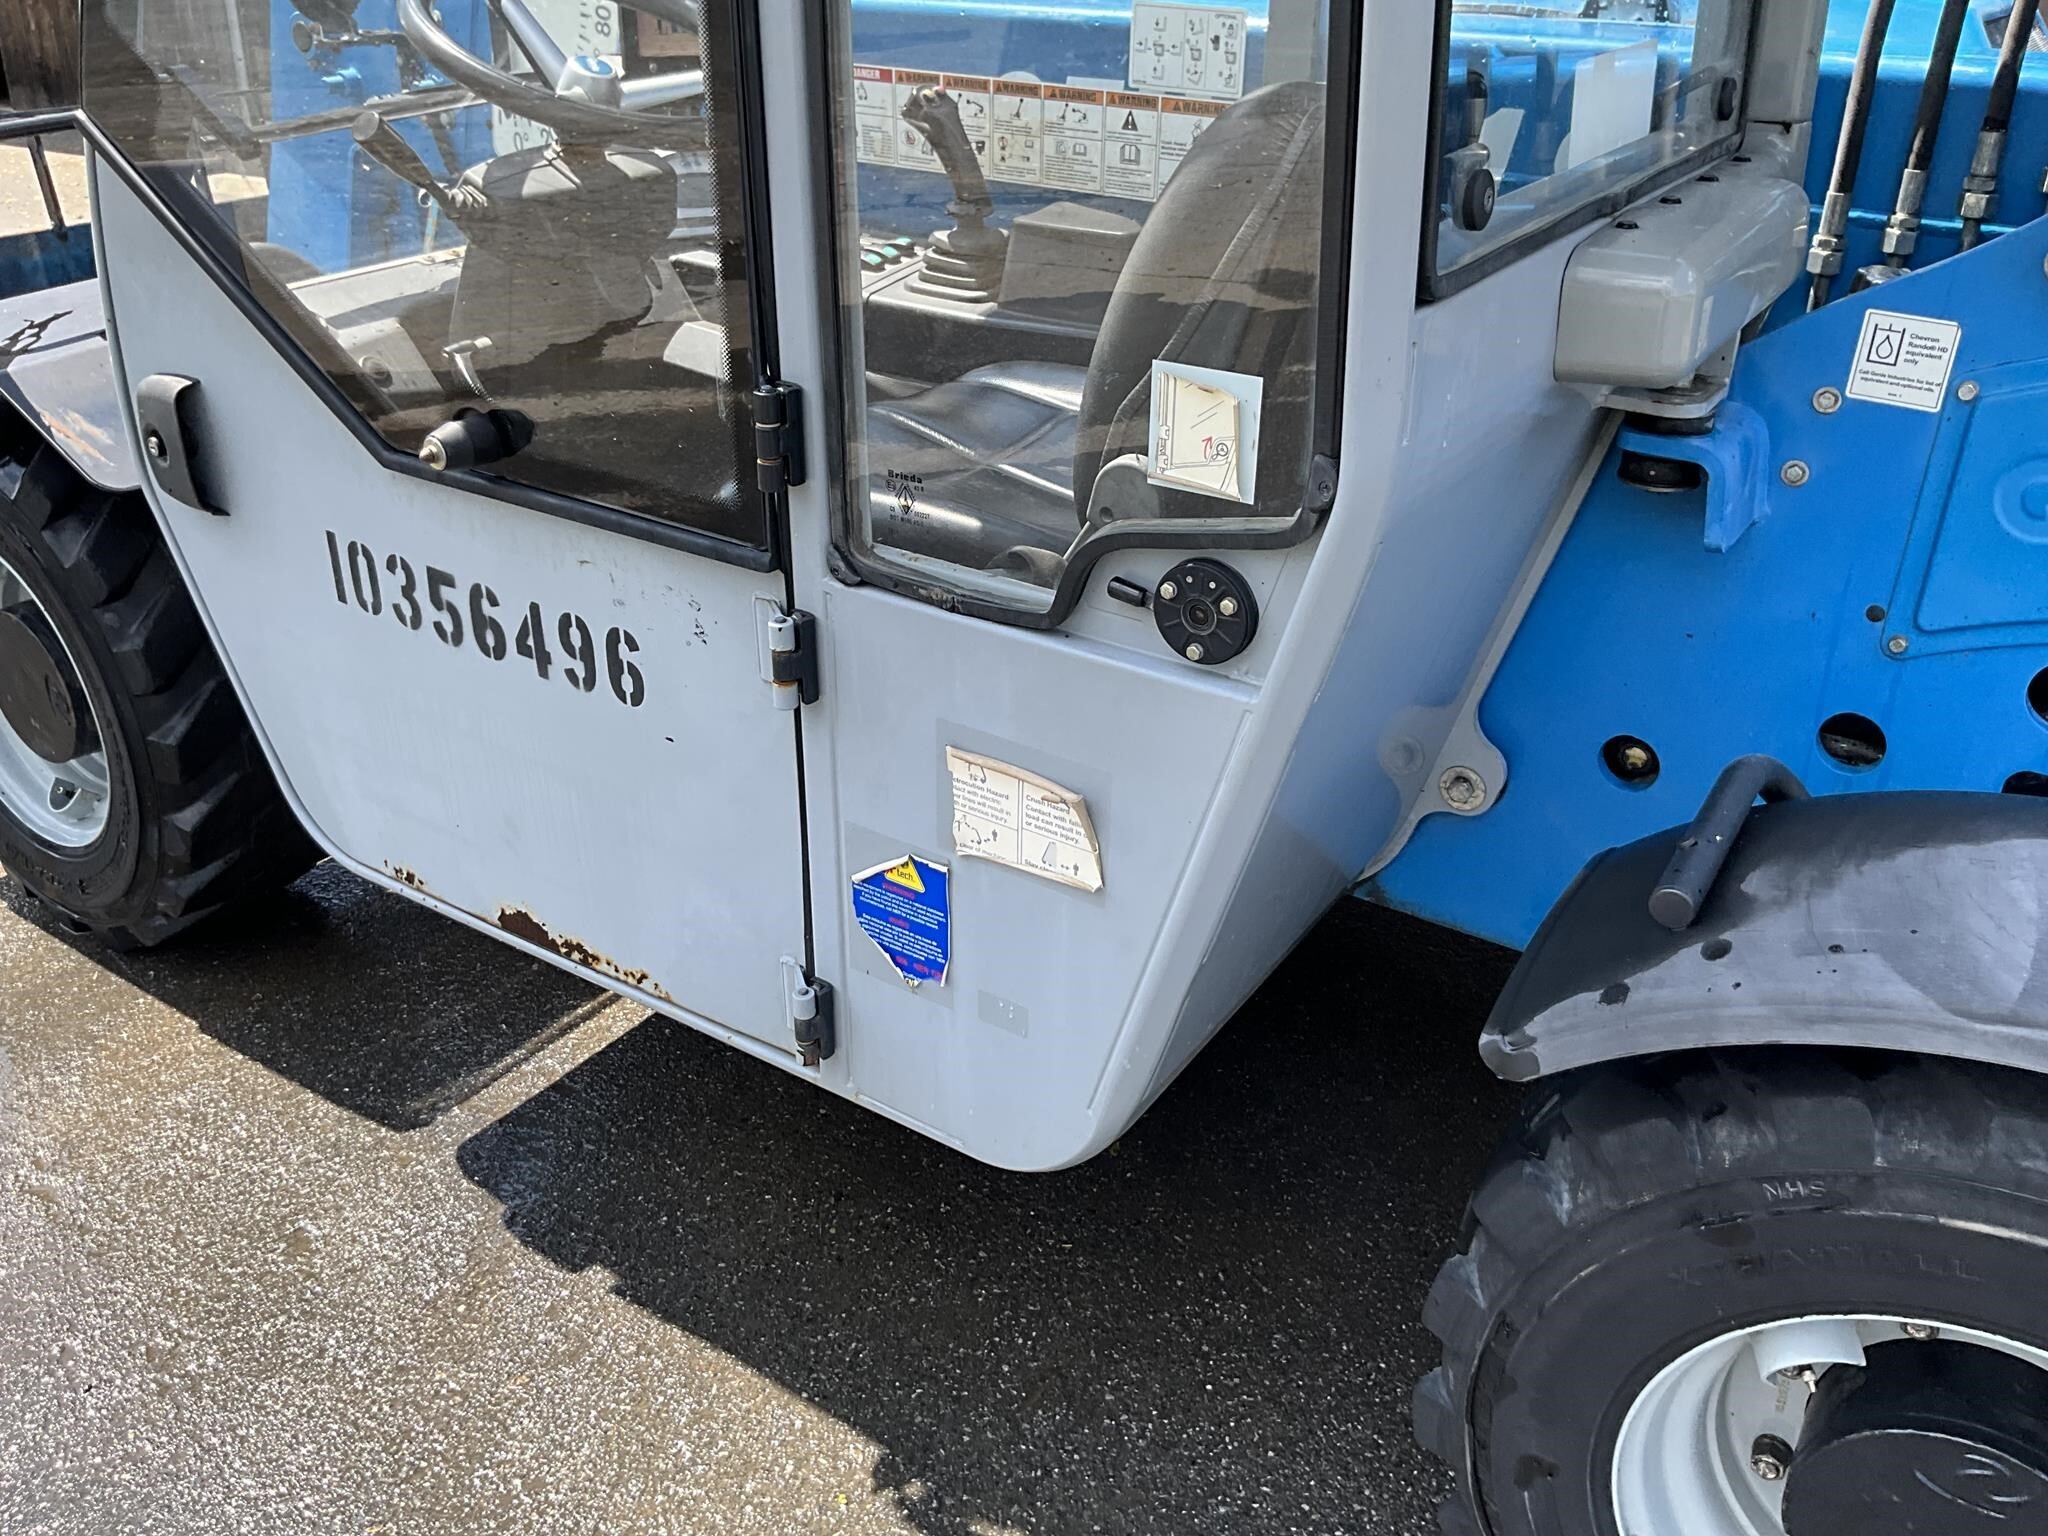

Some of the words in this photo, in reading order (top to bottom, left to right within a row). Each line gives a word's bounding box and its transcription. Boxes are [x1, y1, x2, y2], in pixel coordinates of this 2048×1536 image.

[1910, 332, 1940, 343] Chevron
[1905, 350, 1942, 361] equivalent
[1937, 346, 1949, 354] HD
[1903, 358, 1919, 366] only
[325, 529, 646, 708] 10356496
[986, 786, 1009, 801] Hazard
[1025, 794, 1046, 807] Crush
[1046, 800, 1071, 815] Hazard
[1025, 803, 1052, 818] Contact
[1052, 813, 1068, 824] with
[1025, 811, 1040, 823] load
[1041, 817, 1054, 827] can
[1054, 822, 1074, 834] result
[1075, 829, 1082, 837] in
[1034, 823, 1059, 837] serious
